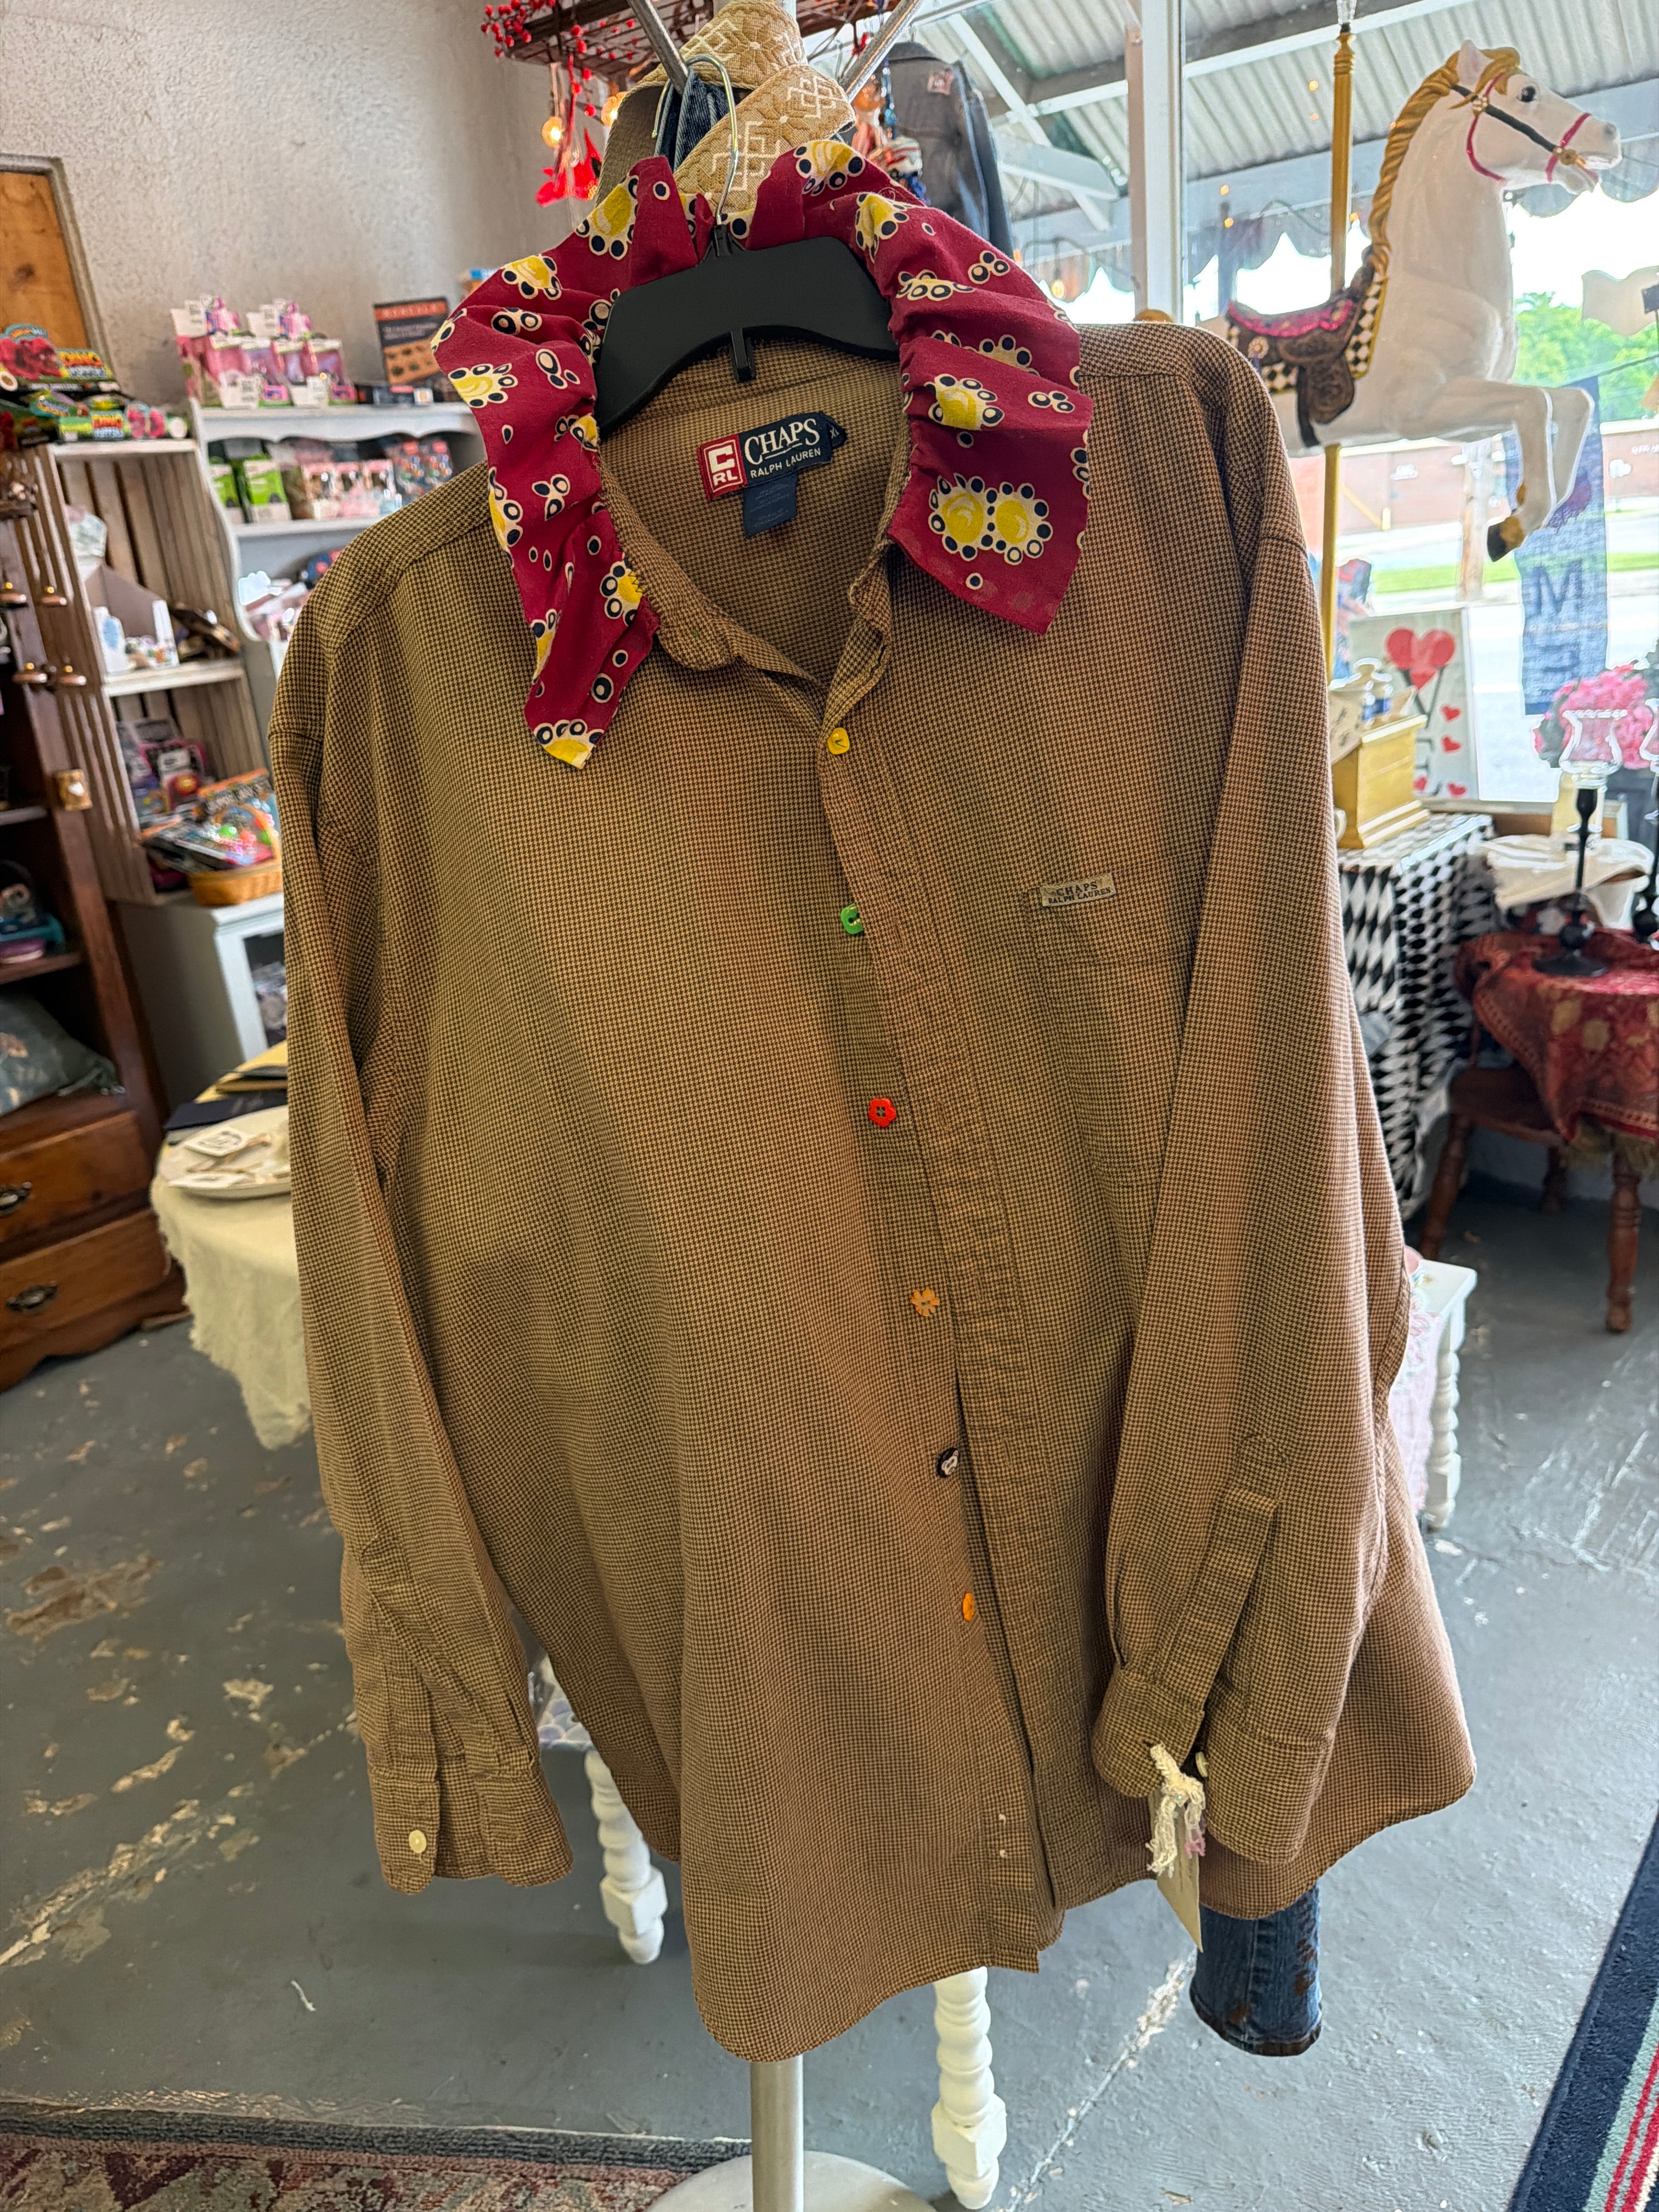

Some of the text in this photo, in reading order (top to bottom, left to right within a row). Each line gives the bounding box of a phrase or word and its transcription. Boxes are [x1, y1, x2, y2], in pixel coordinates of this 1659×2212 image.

[744, 418, 820, 465] CHAPS
[750, 448, 821, 478] RALPH LAUREN
[713, 470, 738, 487] RL
[1048, 887, 1111, 904] RALPH LAUREN
[1056, 881, 1098, 896] CHAPS
